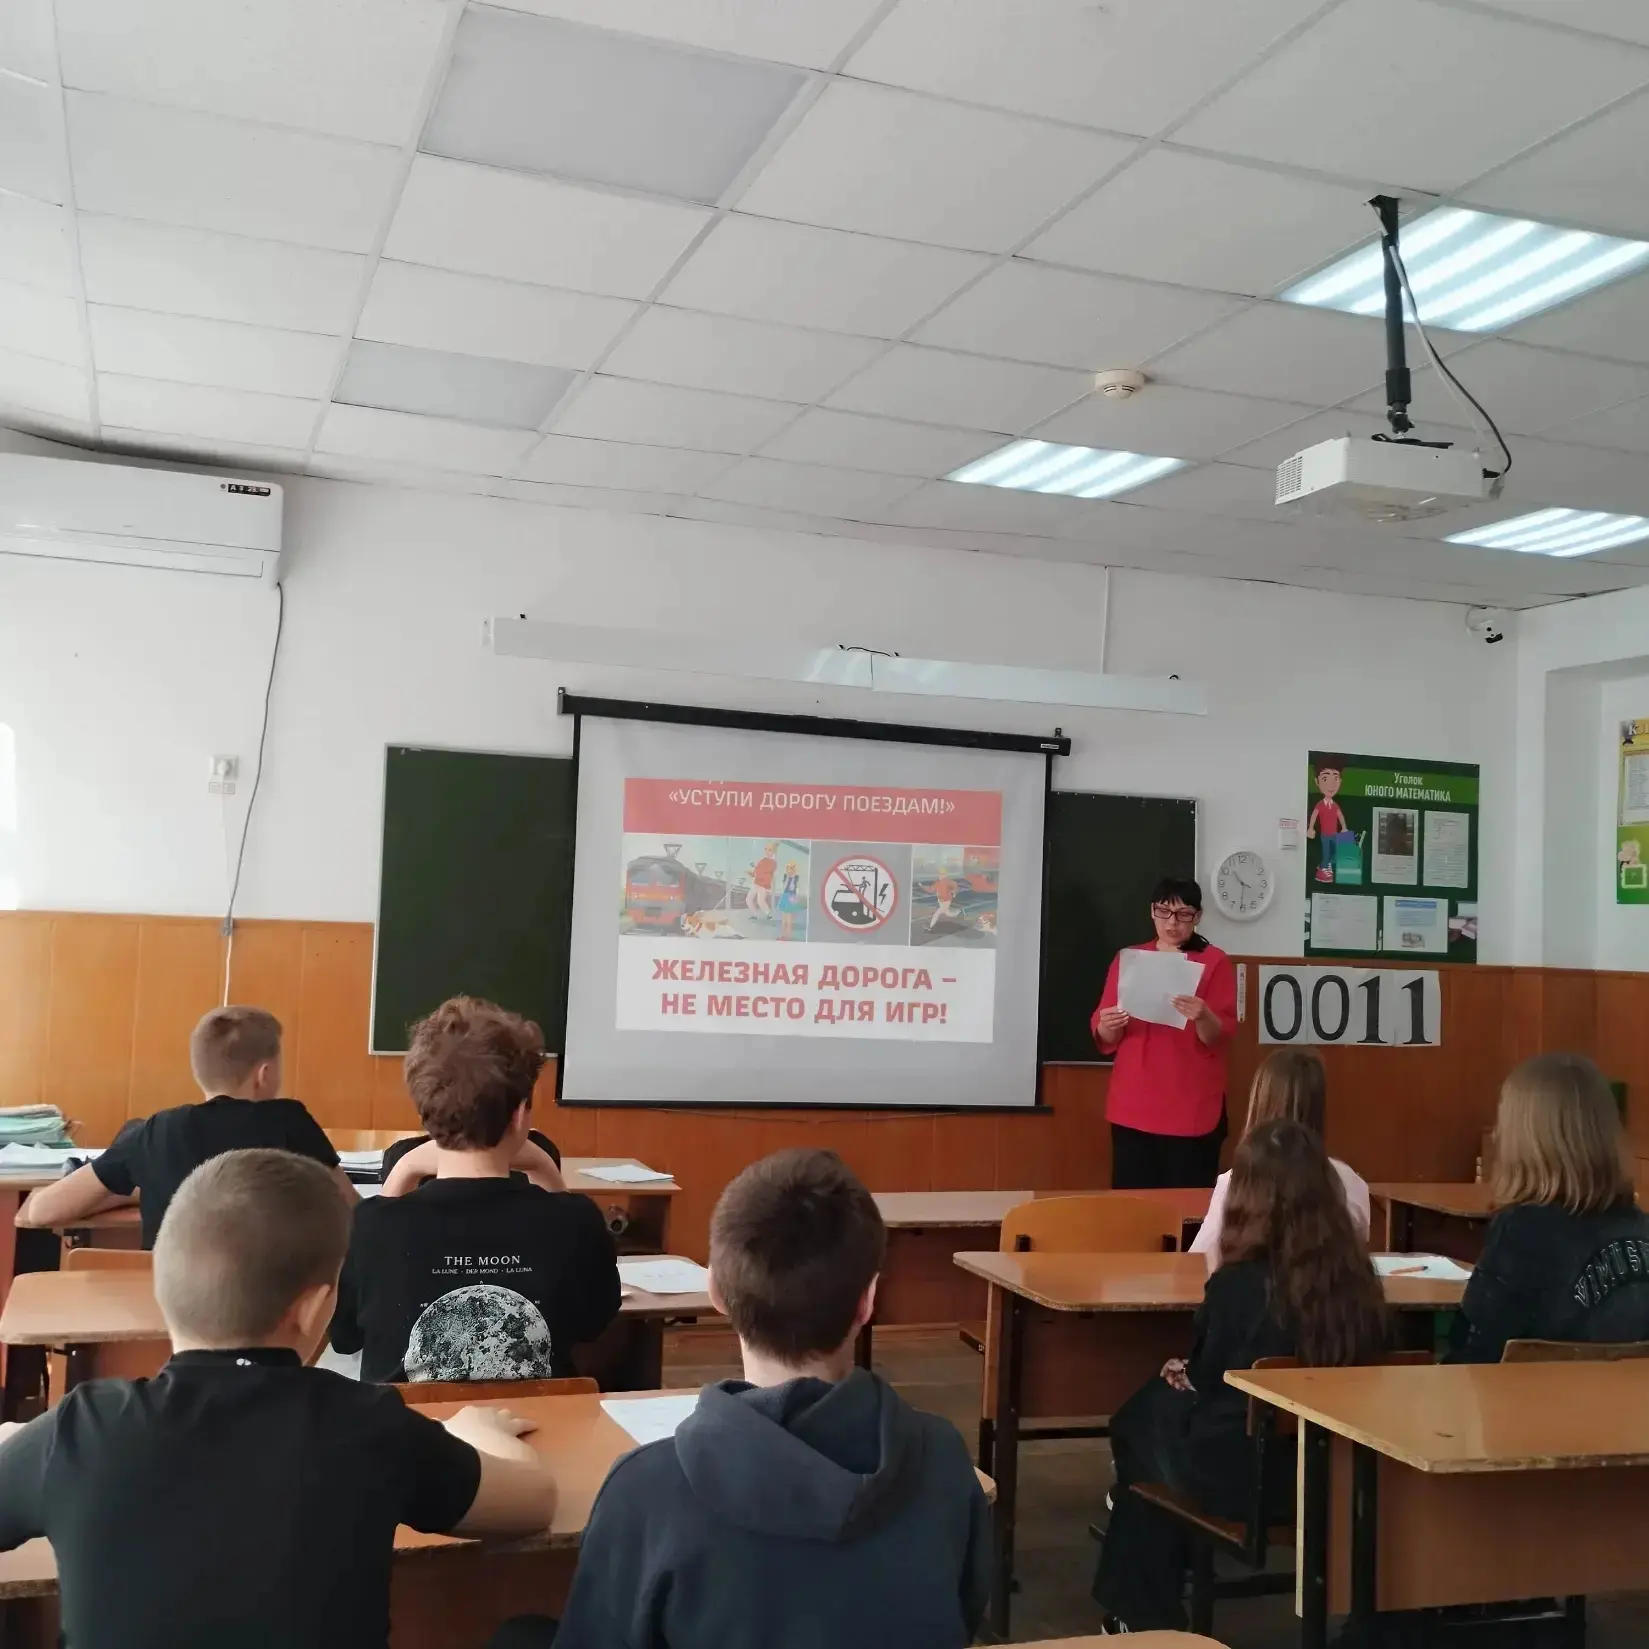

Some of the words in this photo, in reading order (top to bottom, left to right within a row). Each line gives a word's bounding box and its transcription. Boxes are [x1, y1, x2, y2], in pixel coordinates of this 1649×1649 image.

[1394, 772, 1424, 786] Уголок
[668, 788, 753, 808] «УСТУПИ
[760, 792, 837, 811] ДОРОГУ
[843, 795, 955, 815] ПОЕЗДАМ!»
[1364, 784, 1394, 798] ЮНОГО
[1396, 787, 1451, 802] МАТЕМАТИКА
[652, 959, 809, 985] ЖЕЛЕЗНАЯ
[818, 965, 933, 990] ДОРОГА
[661, 993, 697, 1015] НЕ
[707, 994, 805, 1020] МЕСТО
[814, 998, 875, 1024] ДЛЯ
[885, 1001, 947, 1024] ИГР!
[1263, 974, 1433, 1045] 0011
[444, 1256, 473, 1266] THE
[478, 1255, 520, 1266] MOON
